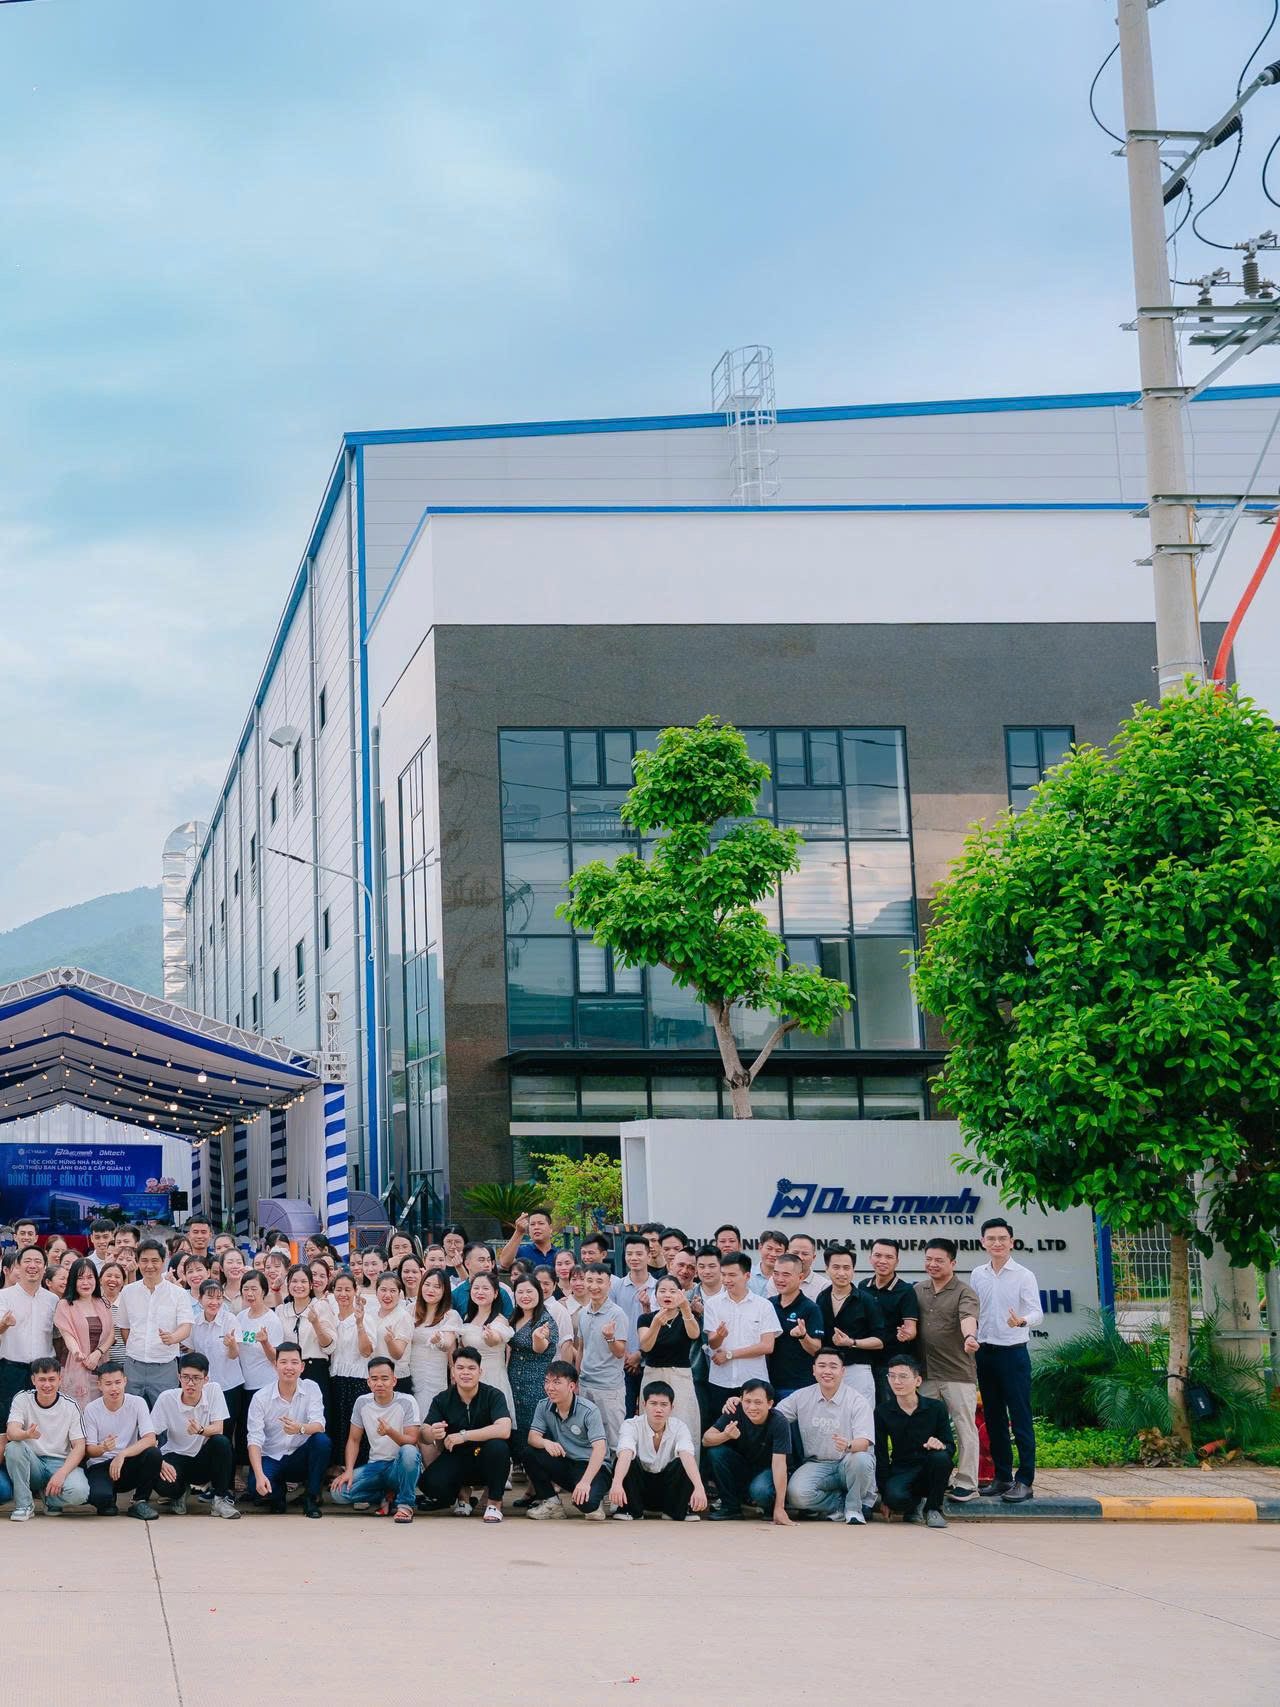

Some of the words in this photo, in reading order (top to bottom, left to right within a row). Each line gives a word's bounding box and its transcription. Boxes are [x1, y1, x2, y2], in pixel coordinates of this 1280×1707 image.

[852, 1215, 975, 1225] REFRIGERATION
[845, 1239, 856, 1251] &
[1037, 1239, 1067, 1251] LTD
[1031, 1330, 1049, 1340] Thọ
